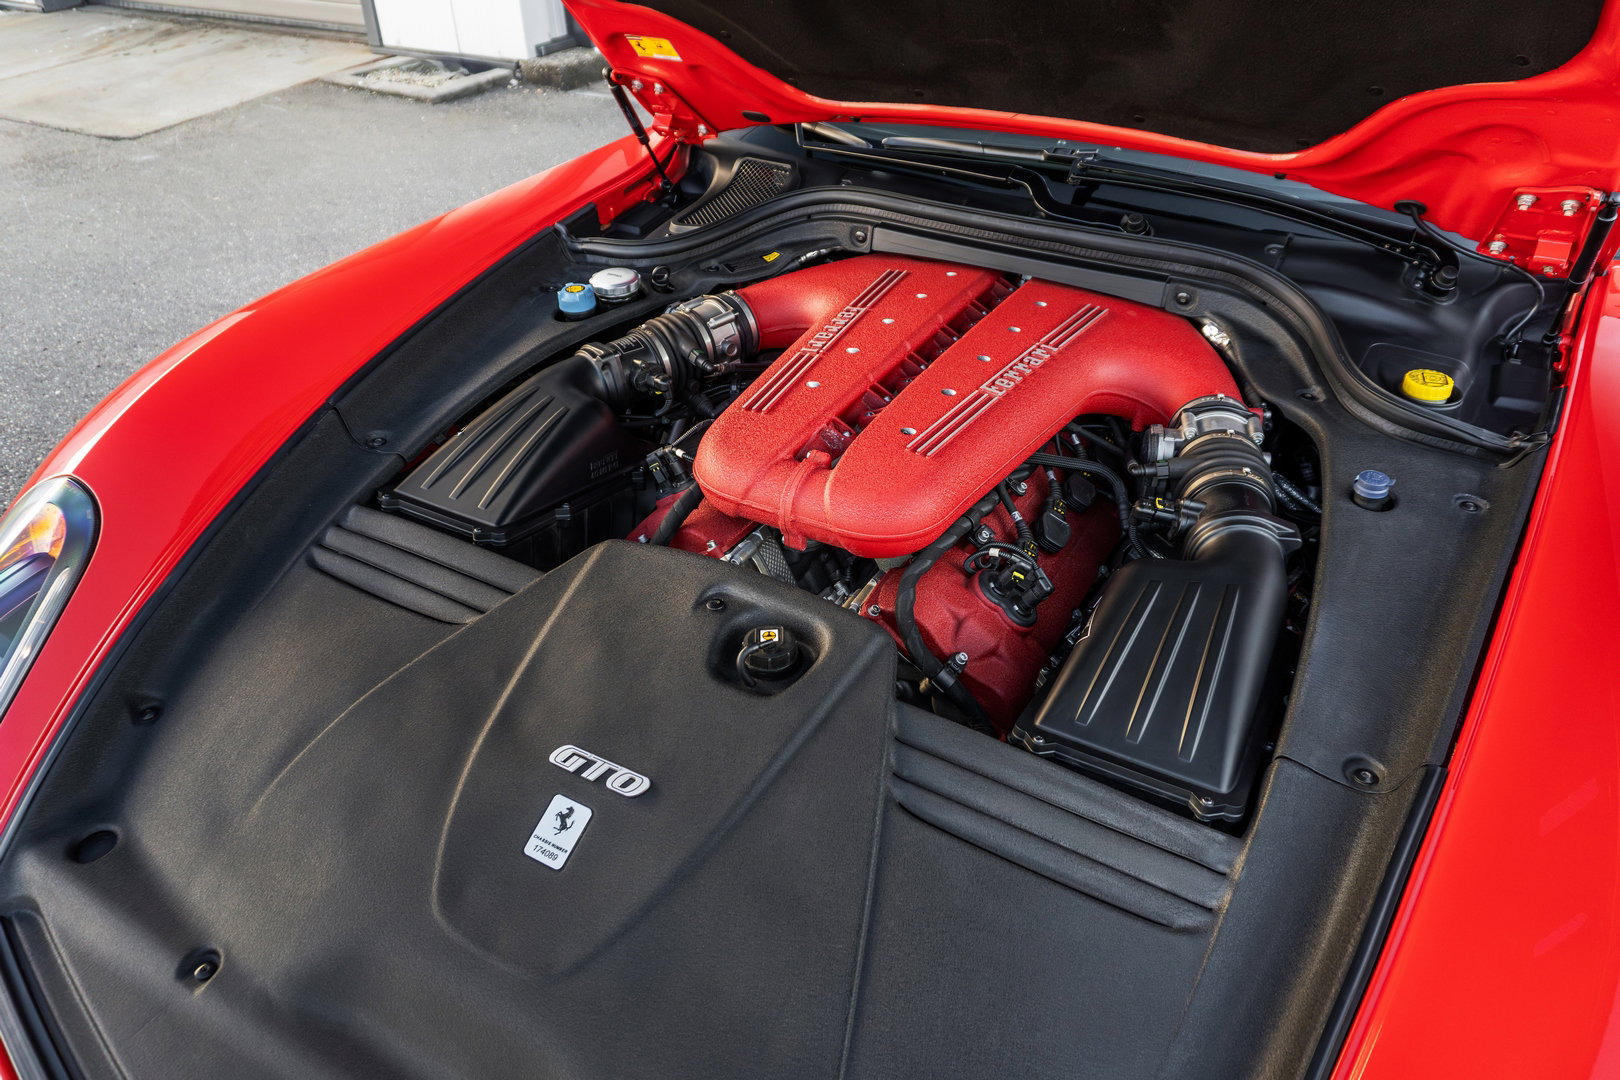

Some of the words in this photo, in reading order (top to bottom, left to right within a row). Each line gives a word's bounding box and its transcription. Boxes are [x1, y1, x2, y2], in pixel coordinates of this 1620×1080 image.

[980, 343, 1059, 396] Ferrari
[549, 744, 651, 797] GTO
[533, 834, 552, 846] CHASSIS
[551, 843, 568, 854] NUMBER
[533, 844, 559, 861] 174089
